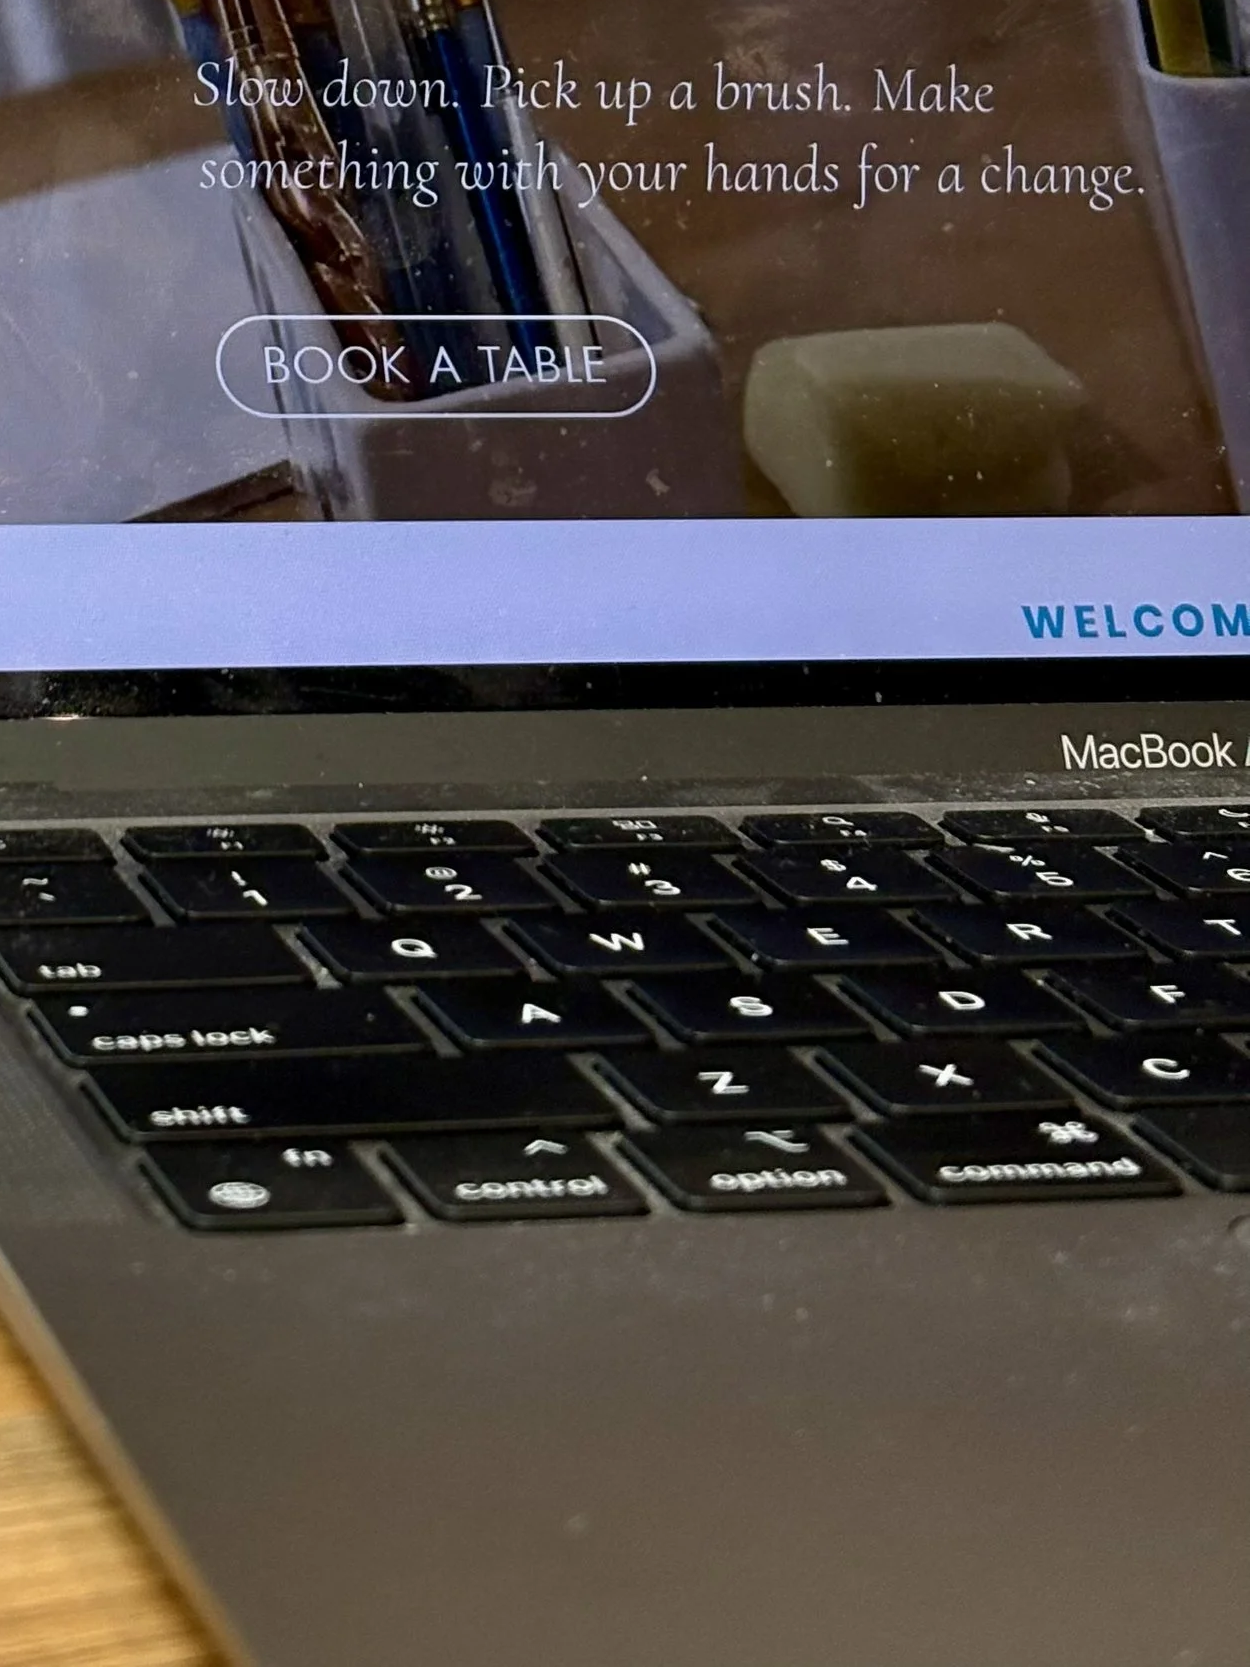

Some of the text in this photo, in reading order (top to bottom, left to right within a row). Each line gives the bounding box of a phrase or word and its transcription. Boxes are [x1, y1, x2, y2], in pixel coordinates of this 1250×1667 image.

[193, 58, 995, 125] Slow down. Pick up a brush. Make
[199, 140, 1146, 211] something with your hands for a change.
[264, 346, 607, 386] BOOK A TABLE
[1022, 603, 1250, 638] WELCOM
[1061, 732, 1237, 770] MacBook
[645, 880, 681, 895] 3
[846, 877, 878, 891] 4
[1035, 871, 1074, 886] 5
[243, 890, 268, 906] 1
[444, 884, 482, 900] 2
[806, 927, 848, 946] E
[1006, 922, 1052, 940] R
[1203, 919, 1242, 936] T
[391, 938, 437, 959] Q
[589, 932, 645, 952] W
[39, 964, 102, 979] tab
[729, 994, 773, 1017] S
[938, 991, 986, 1010] D
[1150, 984, 1186, 1004] F
[522, 1003, 562, 1023] A
[91, 1028, 276, 1051] caps lock
[918, 1063, 974, 1087] X
[1142, 1057, 1190, 1080] C
[698, 1071, 749, 1094] Z
[150, 1104, 250, 1127] shift
[282, 1145, 332, 1168] fn
[709, 1167, 848, 1190] option
[938, 1157, 1142, 1182] command
[455, 1175, 608, 1200] control
